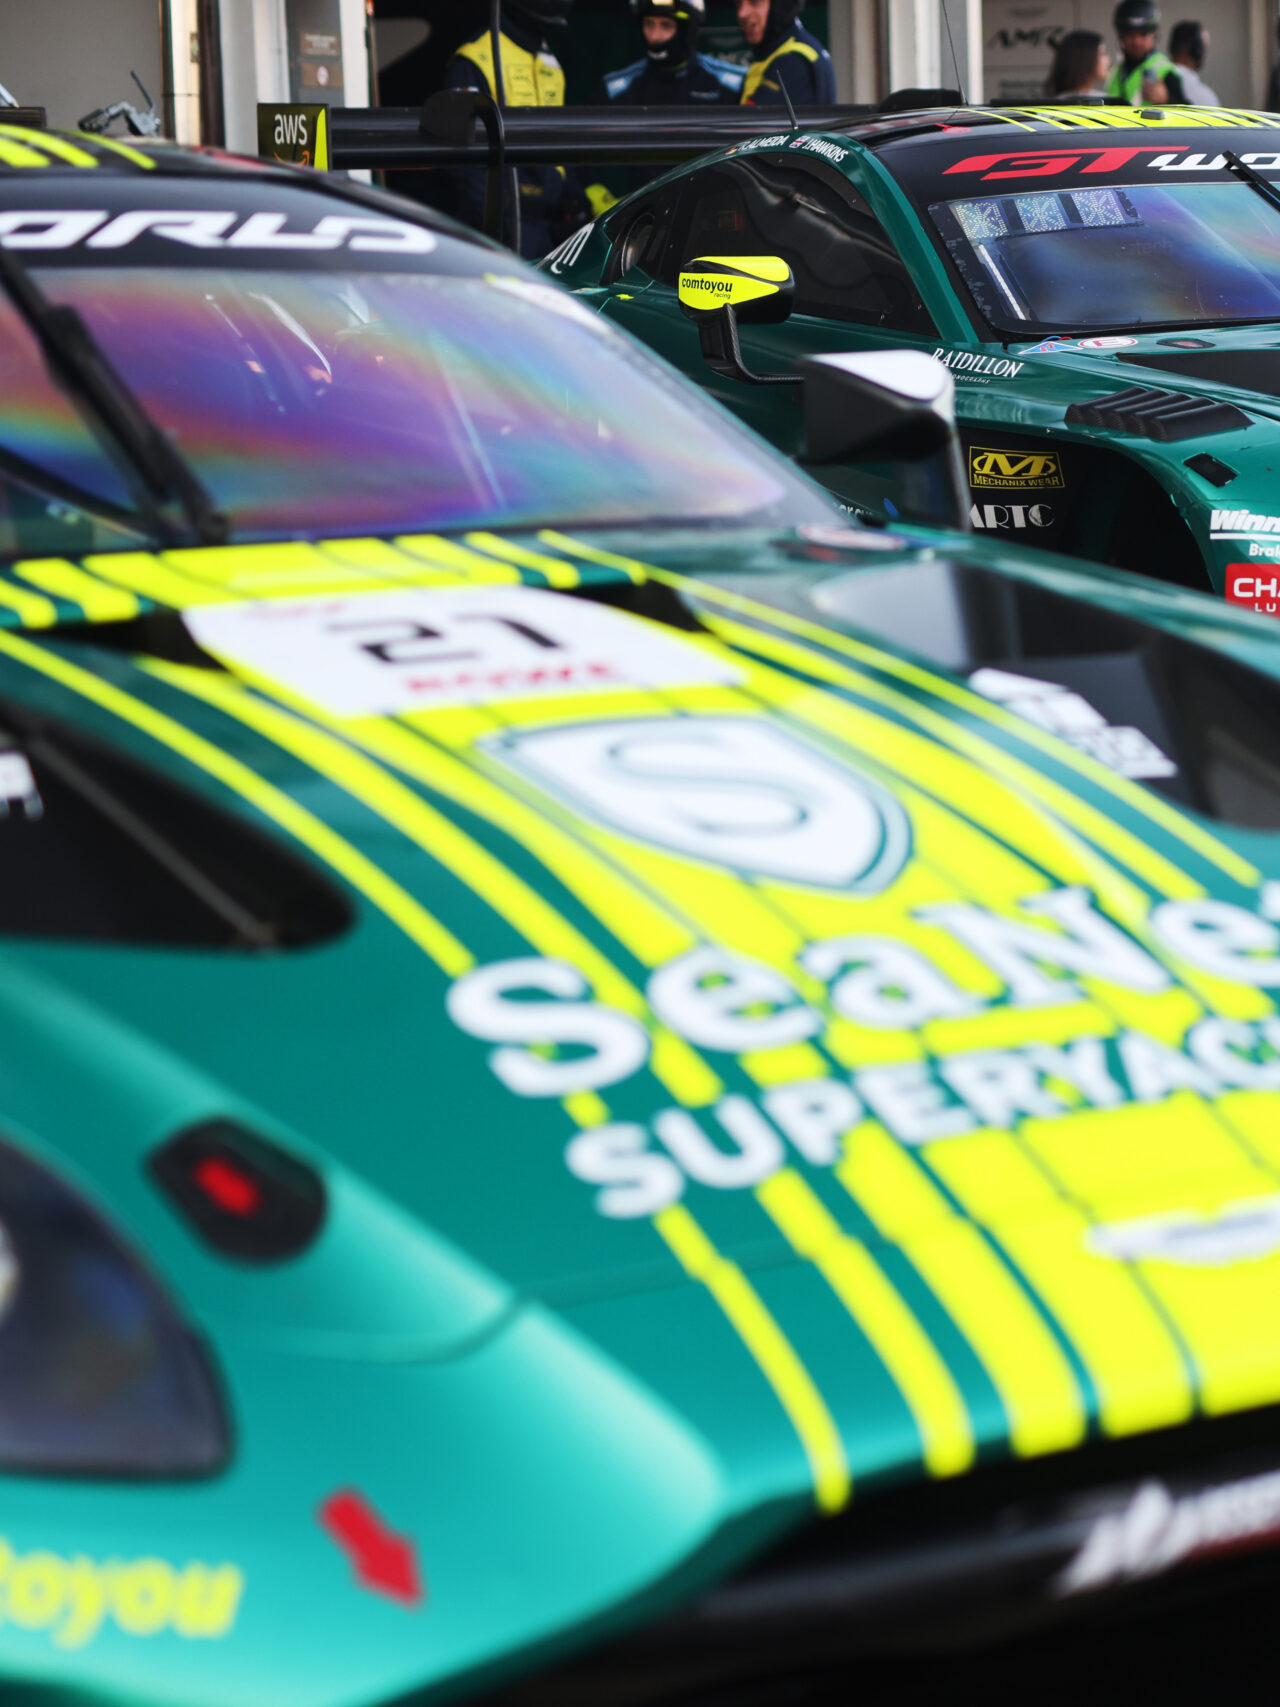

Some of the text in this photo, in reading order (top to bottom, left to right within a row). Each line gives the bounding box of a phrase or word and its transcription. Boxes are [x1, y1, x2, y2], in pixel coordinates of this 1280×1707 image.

[274, 113, 308, 146] aws
[802, 138, 849, 163] J.HAWKINS
[941, 144, 1191, 181] GT
[681, 277, 733, 294] comtoyou
[714, 291, 732, 300] racing
[931, 347, 1025, 378] RAIDILLON
[973, 474, 1060, 487] MECHANIX WEAR
